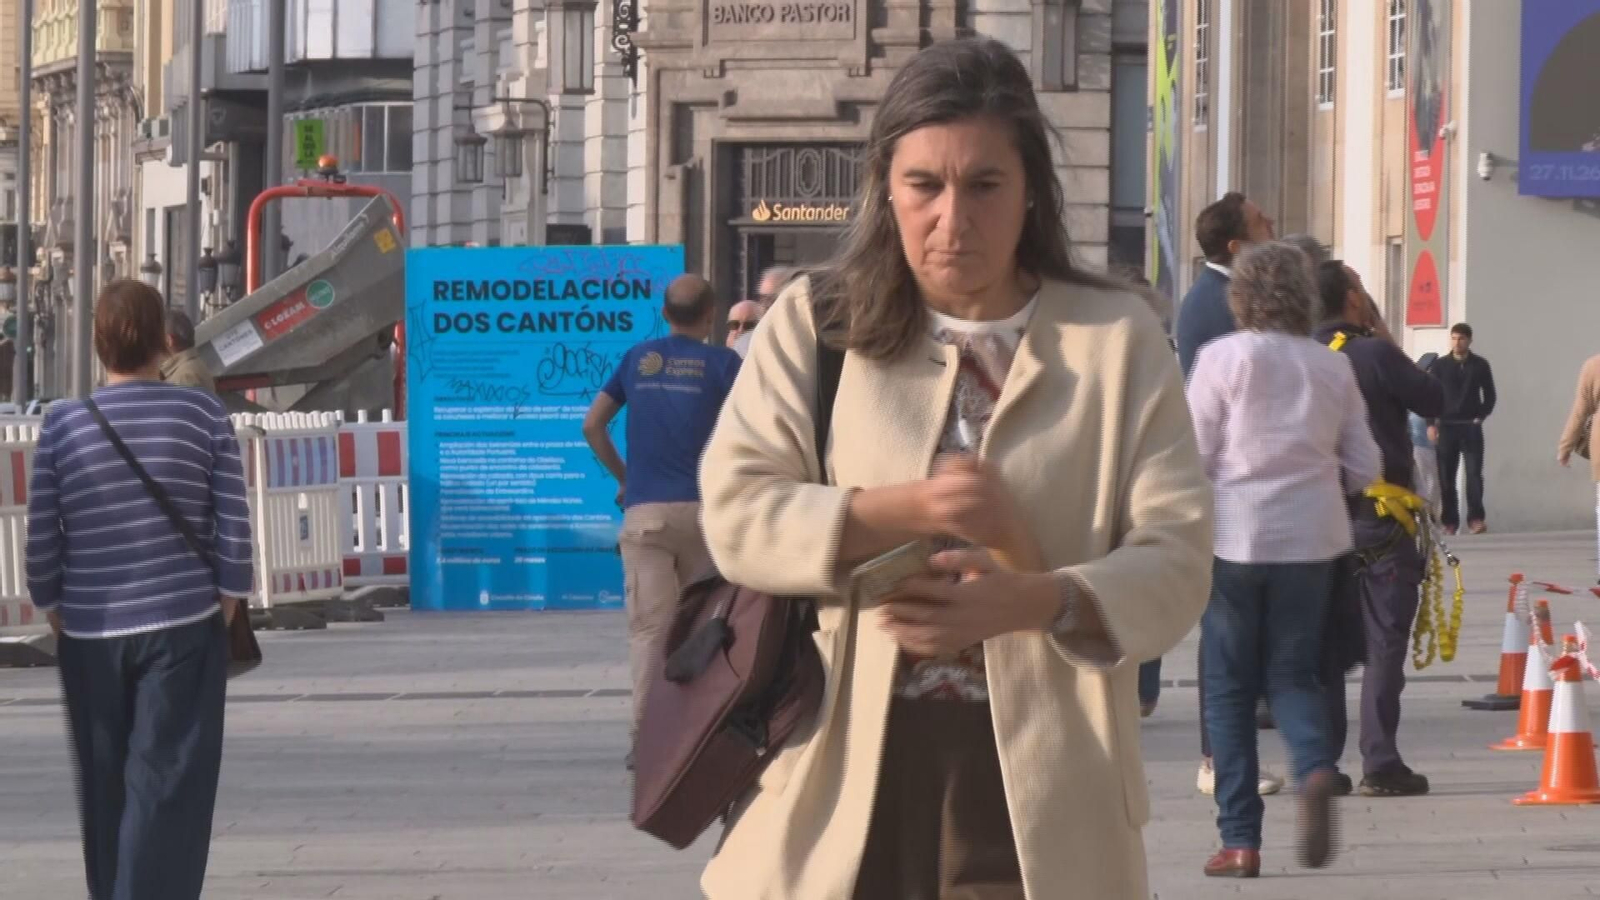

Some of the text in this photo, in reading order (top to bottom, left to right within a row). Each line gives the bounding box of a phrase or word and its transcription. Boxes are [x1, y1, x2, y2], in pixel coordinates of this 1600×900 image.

[714, 2, 850, 24] BANCO PASTOR
[772, 203, 850, 221] Santander
[433, 272, 651, 301] REMODELACIÓN
[434, 305, 633, 334] DOS CANTÓNS
